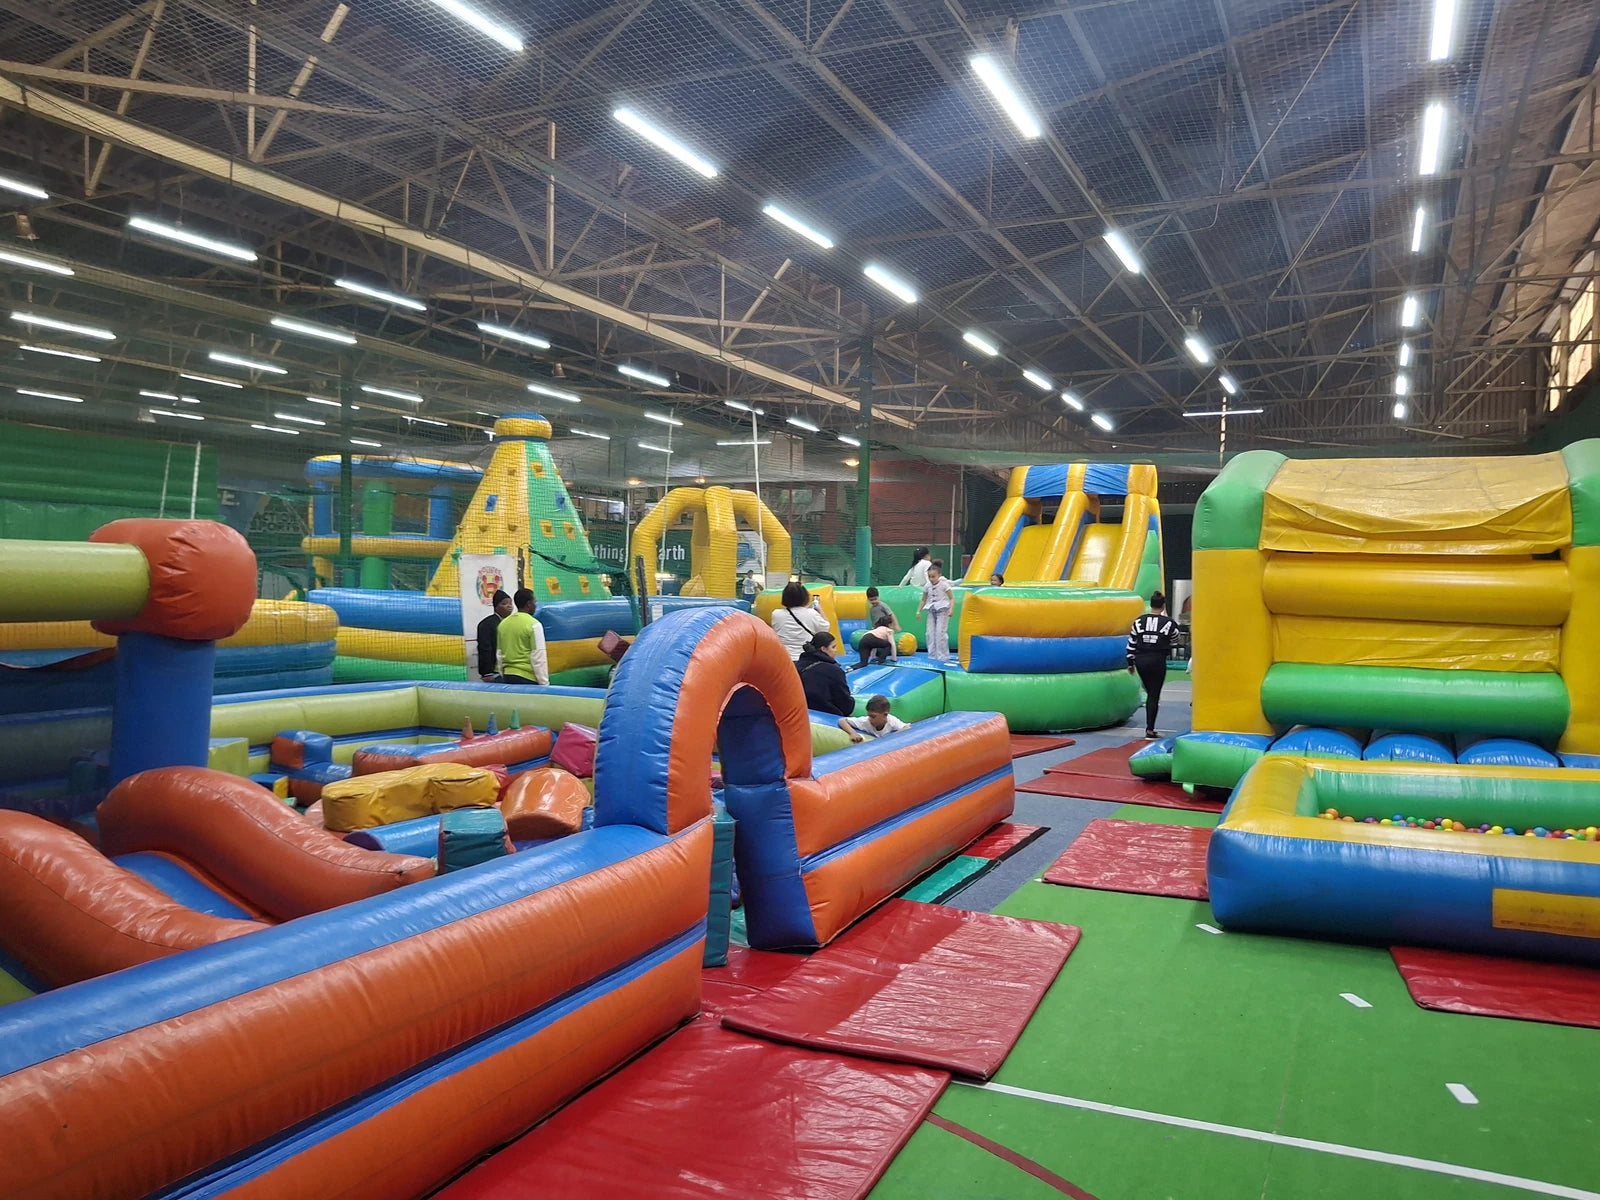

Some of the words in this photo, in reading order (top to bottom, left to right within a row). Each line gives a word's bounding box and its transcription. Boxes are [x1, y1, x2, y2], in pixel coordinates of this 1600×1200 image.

[252, 511, 299, 523] ACTION
[248, 520, 302, 534] SPORTS
[656, 545, 685, 560] arth
